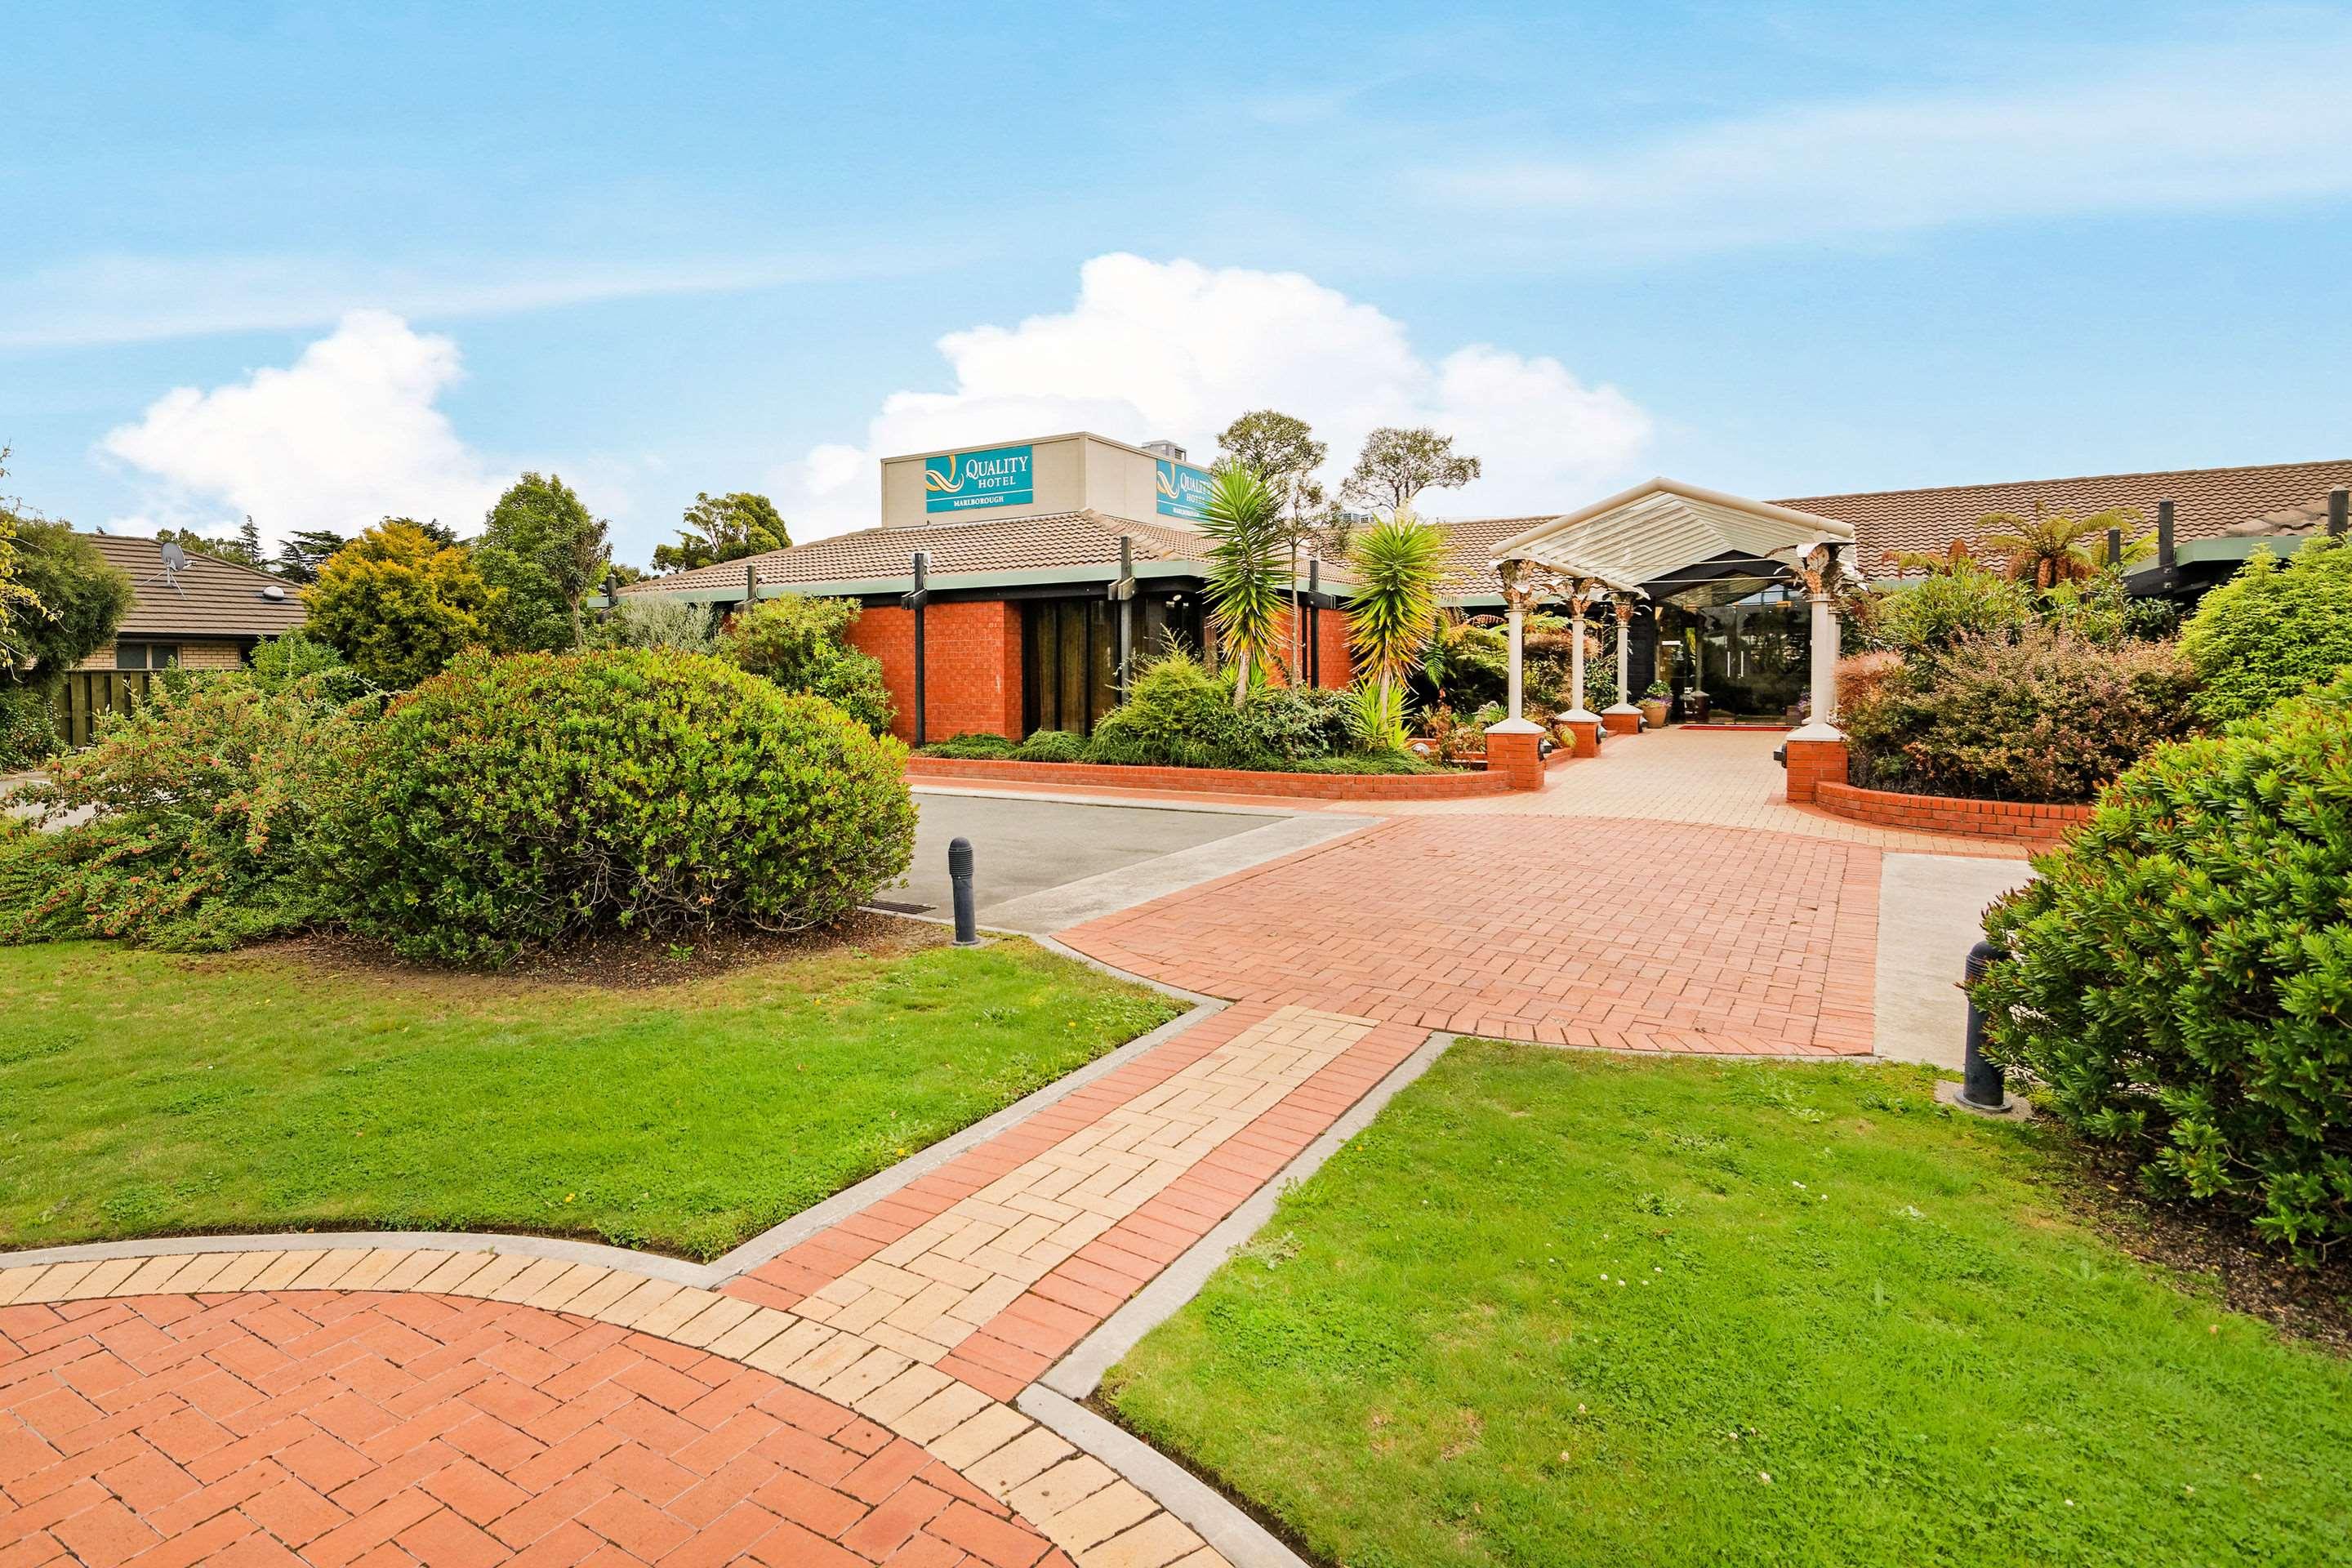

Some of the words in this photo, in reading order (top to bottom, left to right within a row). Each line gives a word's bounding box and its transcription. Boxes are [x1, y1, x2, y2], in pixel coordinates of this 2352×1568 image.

[966, 457, 1028, 479] QUALITY
[978, 476, 1016, 488] HOTEL
[954, 497, 1004, 507] MARLBOROUGH
